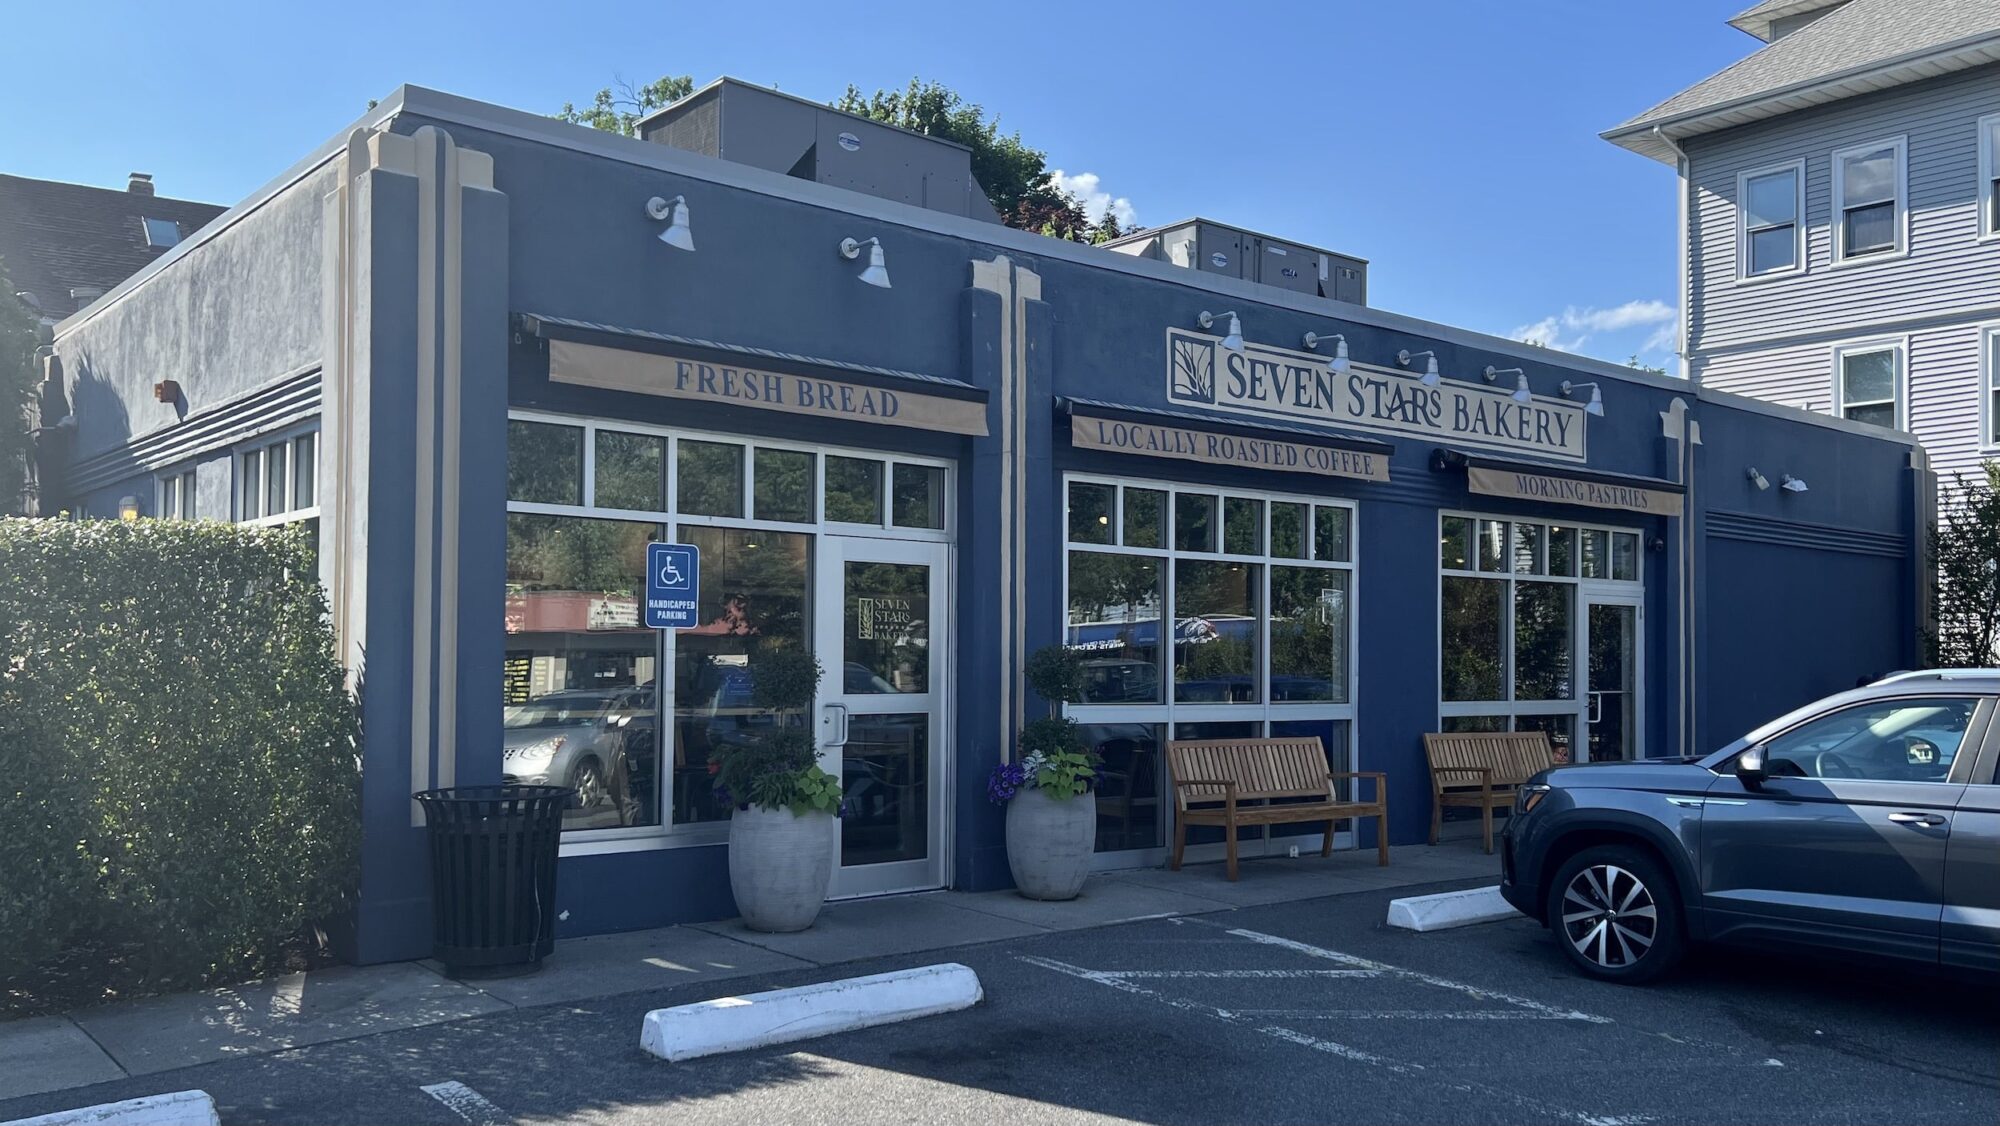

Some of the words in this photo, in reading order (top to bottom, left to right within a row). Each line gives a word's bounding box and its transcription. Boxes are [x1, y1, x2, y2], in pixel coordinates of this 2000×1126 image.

[673, 360, 785, 404] FRESH
[797, 378, 900, 419] BREAD
[1226, 352, 1337, 412] SEVEN
[1348, 374, 1442, 428] STARS
[1453, 393, 1574, 448] BAKERY
[1097, 421, 1198, 455] LOCALLY
[1206, 435, 1298, 467] ROASTED
[1304, 447, 1375, 476] COFFEE
[1515, 474, 1584, 501] MORNING
[1588, 483, 1648, 509] PASTRIES
[648, 599, 696, 610] HANDICAPPED
[657, 610, 687, 620] PARKING
[874, 598, 910, 610] SEVEN
[874, 610, 911, 623] STARS
